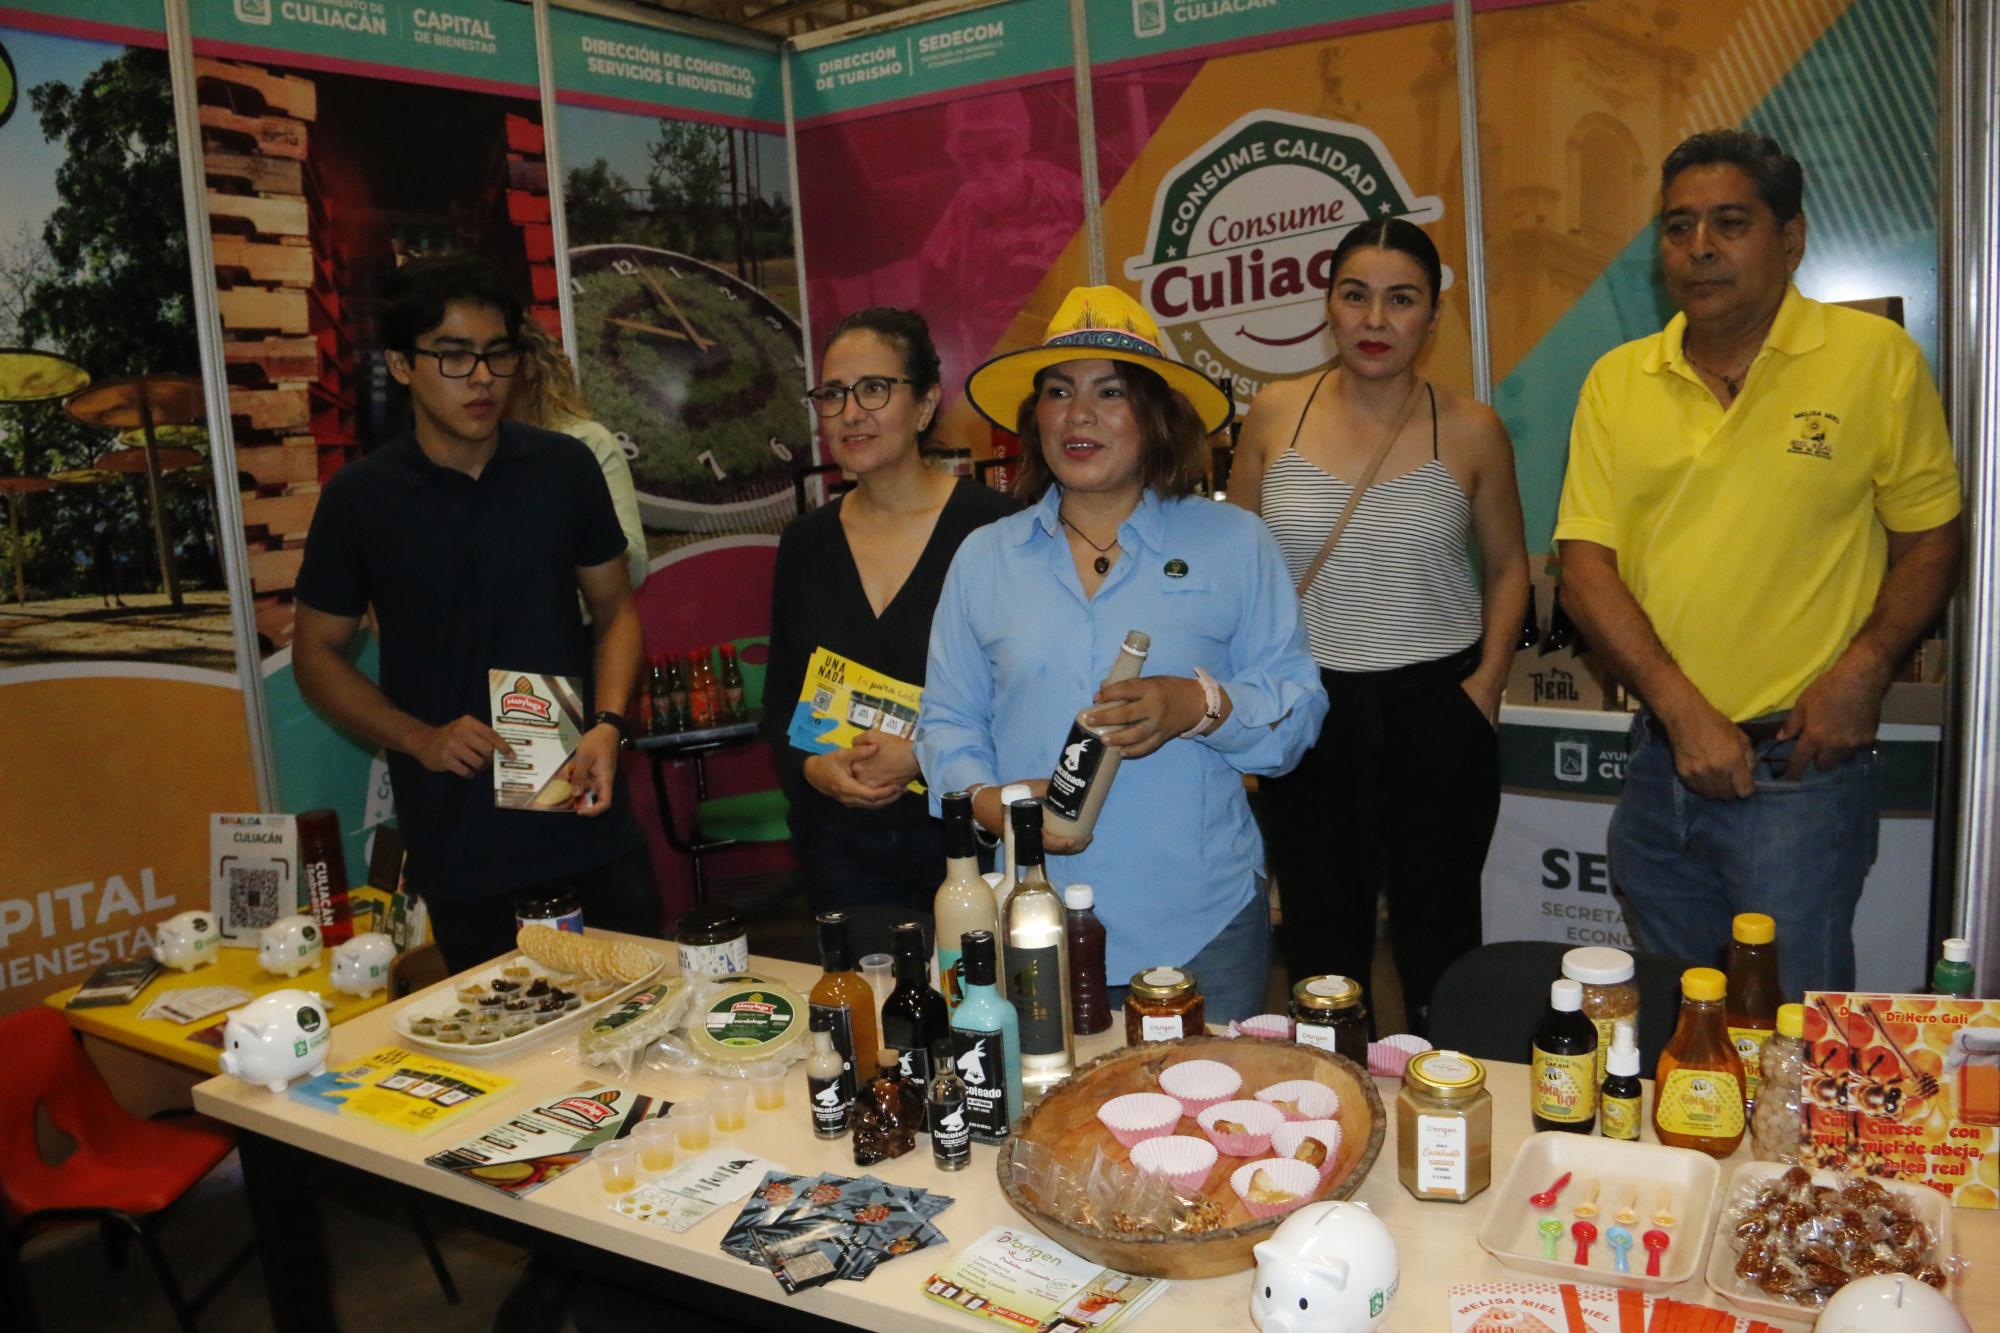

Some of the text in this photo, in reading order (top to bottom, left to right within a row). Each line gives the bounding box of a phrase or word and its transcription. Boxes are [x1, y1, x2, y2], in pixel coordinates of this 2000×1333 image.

[413, 8, 496, 40] CAPITAL
[918, 21, 1005, 53] SEDECOM
[415, 31, 497, 55] DE BIENESTAR
[582, 36, 756, 84] DIRECCIÓN DE COMERCIO,
[819, 45, 897, 74] DIRECCIÓN
[587, 57, 753, 98] SERVICIOS E INDUSTRIAS
[816, 62, 903, 91] DE TURISMO
[1171, 138, 1378, 237] CONSUME CALIDAD
[1207, 198, 1345, 247] Consume
[611, 259, 639, 276] 12
[1150, 248, 1334, 318] Culiac
[614, 431, 640, 460] 8
[770, 436, 793, 462] 6
[697, 449, 727, 481] 7
[817, 665, 845, 686] NADA
[824, 655, 846, 674] UNA
[233, 832, 283, 845] CULIACÁN
[1541, 848, 1608, 895] SE
[1541, 901, 1625, 924] SECRETA
[1566, 926, 1635, 948] ECONO
[0, 926, 156, 992] IENESTA
[1886, 1012, 1969, 1025] Dr Hero Gali
[1949, 1127, 1981, 1140] con
[1862, 1138, 1985, 1161] miel de abeja,
[1931, 1161, 1966, 1176] real
[1458, 1297, 1558, 1316] MELISA MIEL
